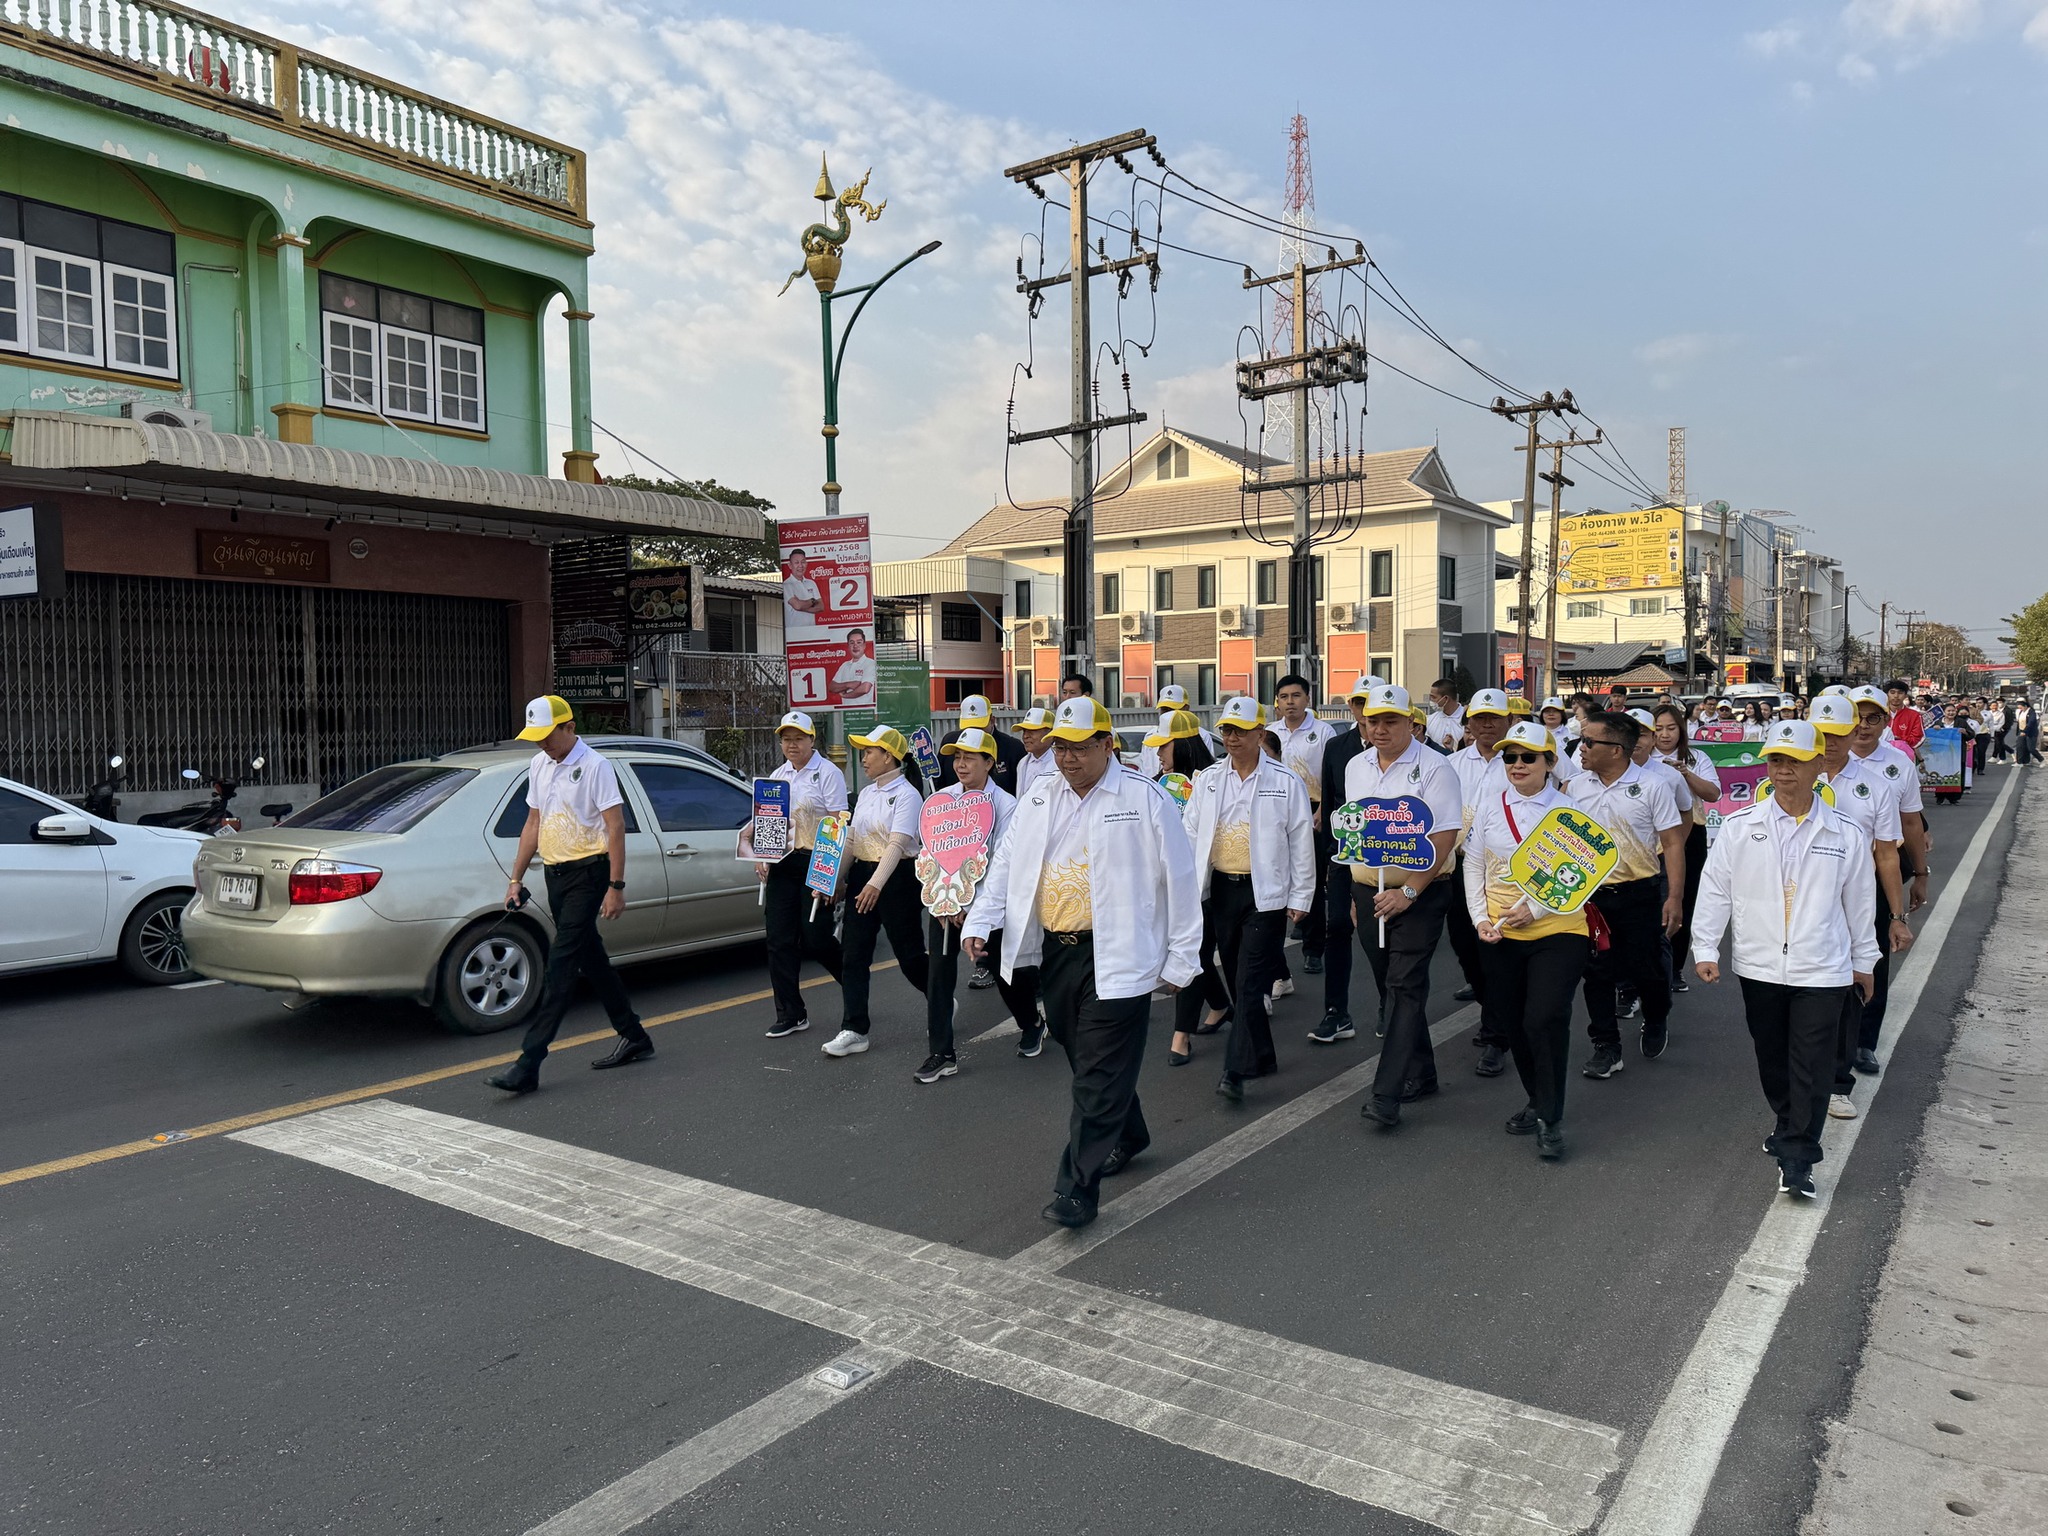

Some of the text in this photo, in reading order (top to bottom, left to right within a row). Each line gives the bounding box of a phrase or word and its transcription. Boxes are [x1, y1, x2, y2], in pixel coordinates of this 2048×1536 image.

[1580, 511, 1663, 530] ห้องภาพ พ.วิไล
[213, 536, 315, 571] วุ้นเดือนเพ็ญ
[838, 544, 860, 552] 2568
[839, 579, 860, 607] 2
[559, 667, 604, 687] อาหารตามสั่ง
[802, 672, 817, 699] 1
[763, 790, 781, 798] VOTE
[926, 792, 992, 816] ชาวหนองคาย
[932, 807, 979, 836] พร้อมใจ
[1364, 801, 1413, 822] เลือกตั้ง
[1386, 820, 1425, 835] เป็นหน้าที่
[1557, 812, 1615, 856] เลือกตั้งครั้งนี้
[931, 826, 983, 853] ไปเลือกตั้ง
[1362, 836, 1416, 851] เลือกคนดี
[1381, 851, 1429, 866] ด้วยมือเรา
[1542, 830, 1597, 875] อย่างสุจริตและโปร่งใส
[235, 878, 253, 895] 7614
